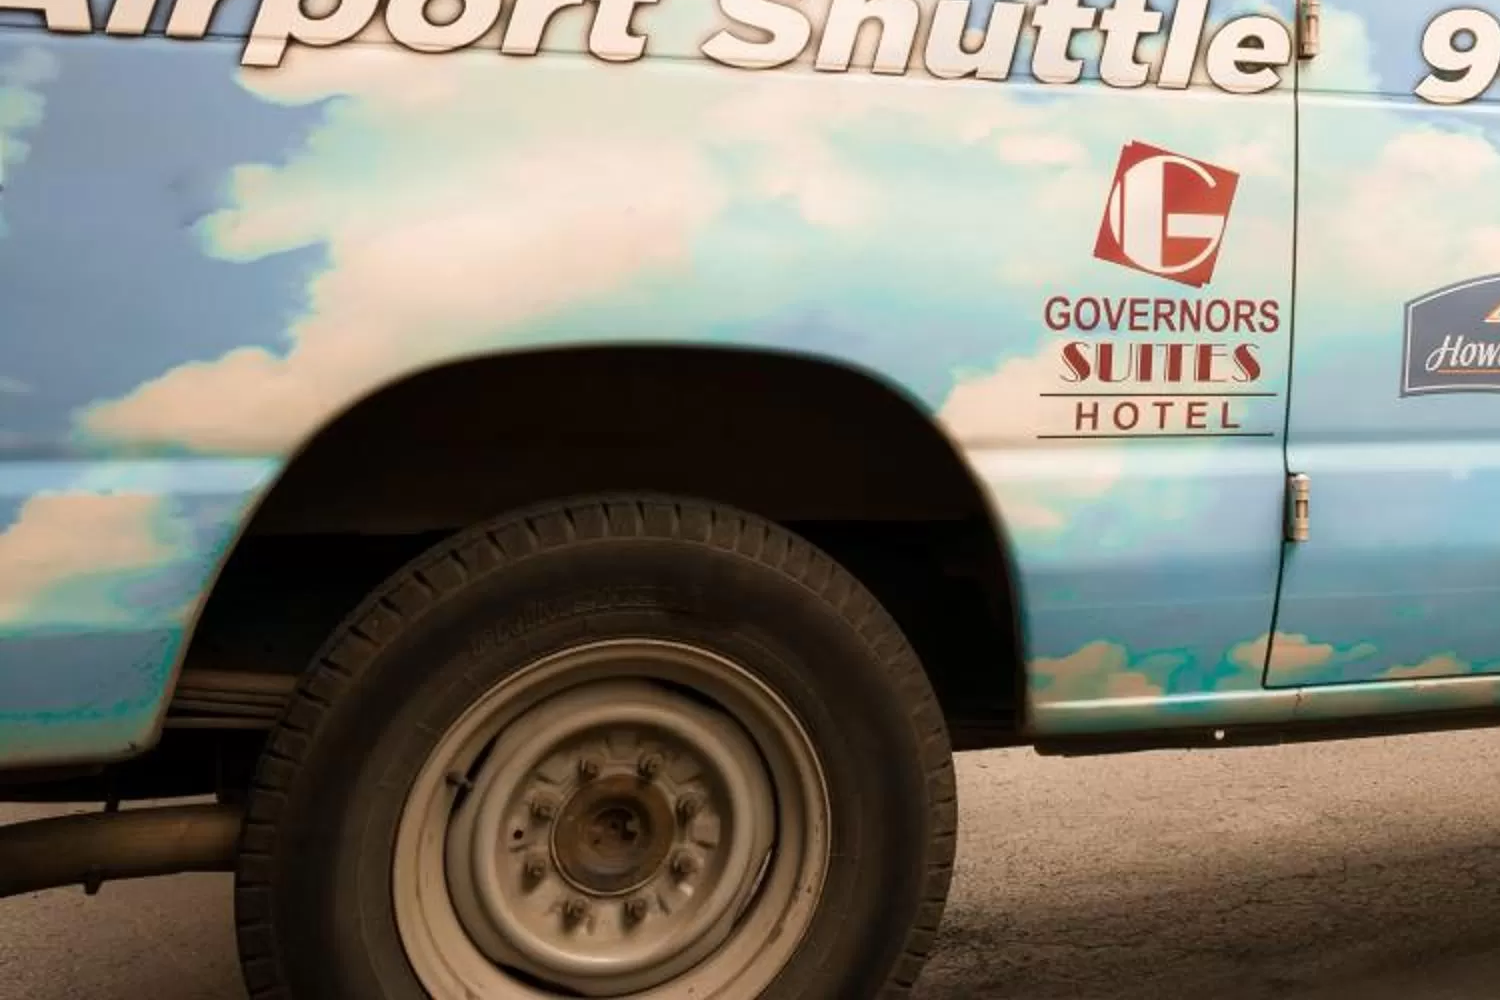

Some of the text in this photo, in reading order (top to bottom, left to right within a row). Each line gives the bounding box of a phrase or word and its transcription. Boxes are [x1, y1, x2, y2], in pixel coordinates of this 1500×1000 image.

[1044, 295, 1280, 333] GOVERNORS
[1060, 341, 1261, 383] SUITES
[1074, 401, 1241, 431] HOTEL
